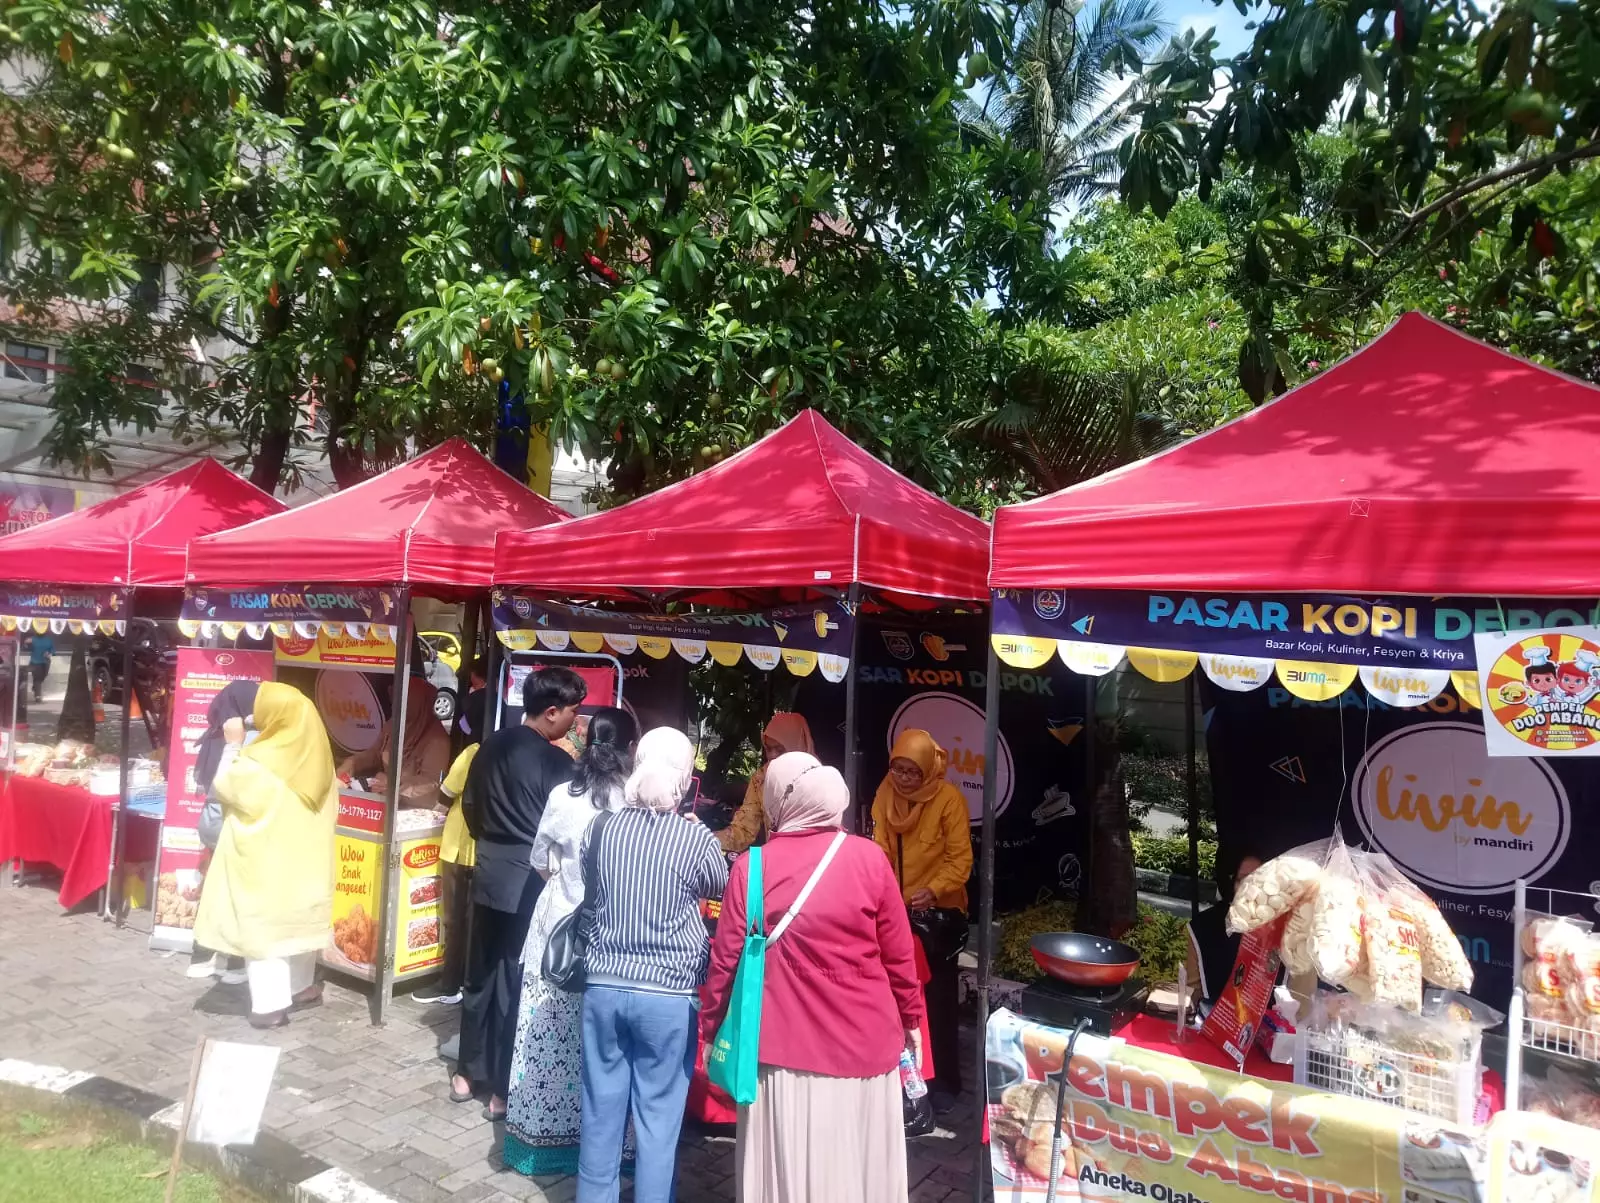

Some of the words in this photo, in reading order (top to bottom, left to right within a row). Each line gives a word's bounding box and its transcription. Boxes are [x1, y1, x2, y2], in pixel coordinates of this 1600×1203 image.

[230, 593, 269, 608] PASAR
[306, 594, 358, 609] DEPOK
[1148, 596, 1290, 633] PASAR
[1302, 602, 1418, 640] KOPI
[1434, 607, 1600, 641] DEPO
[1266, 639, 1294, 651] Bazar
[1297, 641, 1324, 653] Kopi,
[1328, 643, 1370, 657] Kuliner,
[1373, 646, 1416, 660] Fesyen
[1419, 648, 1429, 658] &
[1433, 649, 1465, 661] Kriya
[859, 666, 903, 684] SAR
[906, 667, 965, 687] KOPI
[968, 672, 1055, 697] DPOK
[1372, 671, 1431, 694] livin
[1535, 702, 1585, 714] PEMPEK
[1512, 713, 1546, 731] DUO
[1376, 764, 1534, 836] livin
[339, 803, 383, 821] 16-1779-1127
[1454, 832, 1472, 848] by
[1473, 836, 1534, 852] mandiri
[340, 844, 365, 863] Wow
[341, 865, 361, 880] Enak
[1437, 898, 1476, 917] liner,
[1021, 1028, 1323, 1156] Pempek
[1073, 1100, 1173, 1162] Duo
[1080, 1164, 1146, 1197] Aneka
